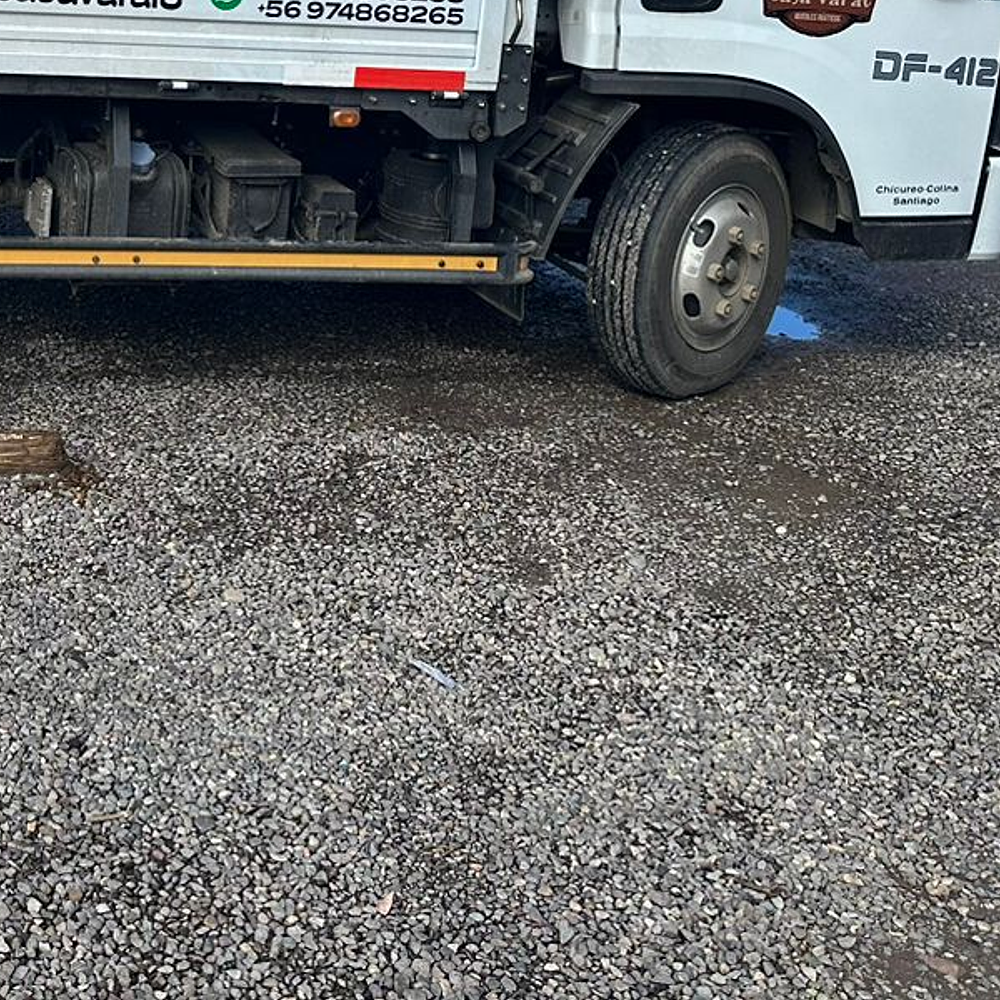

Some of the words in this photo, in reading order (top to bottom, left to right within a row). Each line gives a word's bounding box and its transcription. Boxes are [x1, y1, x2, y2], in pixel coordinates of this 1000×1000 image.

[257, 0, 302, 19] +56
[306, 2, 465, 26] 974868265
[872, 49, 999, 88] DF-412
[892, 196, 941, 206] Santiago
